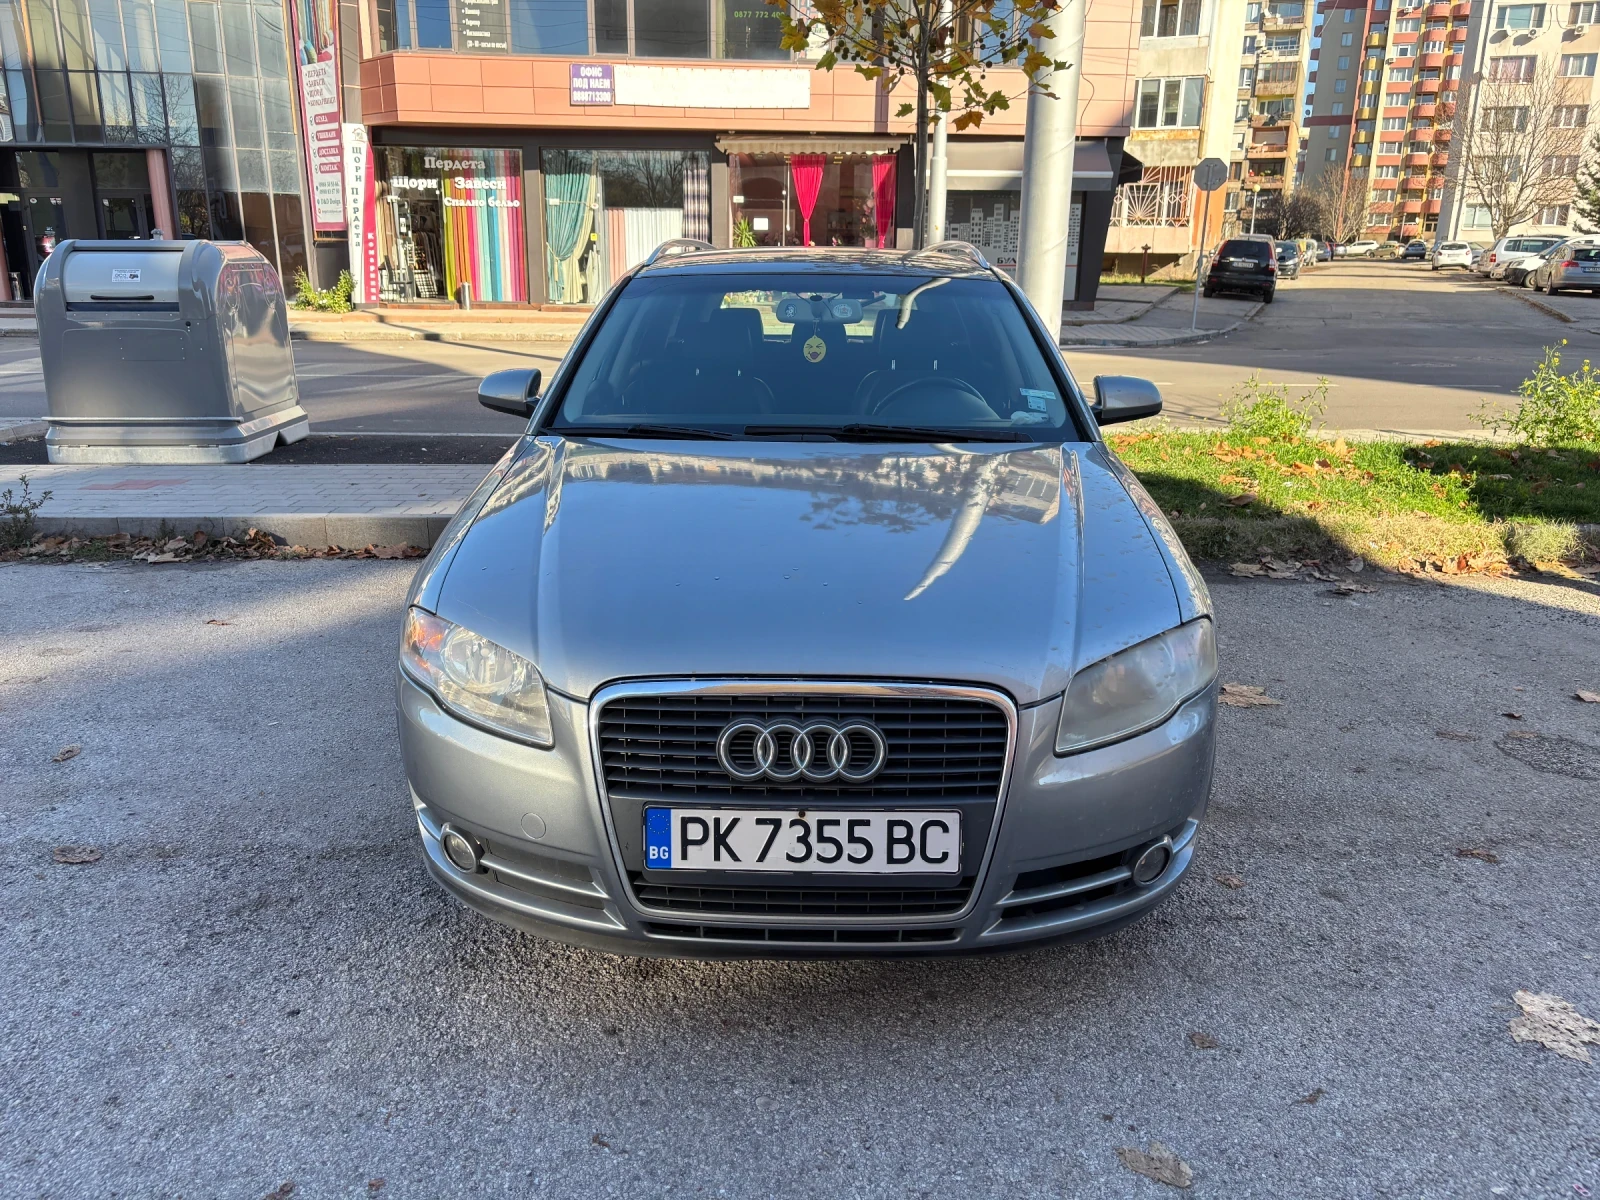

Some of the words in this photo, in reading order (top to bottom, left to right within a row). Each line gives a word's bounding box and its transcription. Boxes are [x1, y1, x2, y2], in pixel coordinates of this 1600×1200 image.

[734, 10, 752, 18] 0877
[580, 66, 603, 78] ОФИС
[572, 77, 589, 90] ПОД
[589, 78, 611, 89] НАЕМ
[424, 156, 486, 171] Пердета
[391, 176, 438, 191] Щори
[454, 176, 507, 190] Завеси
[443, 197, 486, 208] Спално
[487, 196, 520, 208] бельо
[680, 816, 742, 863] PK
[755, 818, 874, 865] 7355
[886, 819, 950, 865] BC
[649, 845, 669, 859] BG
